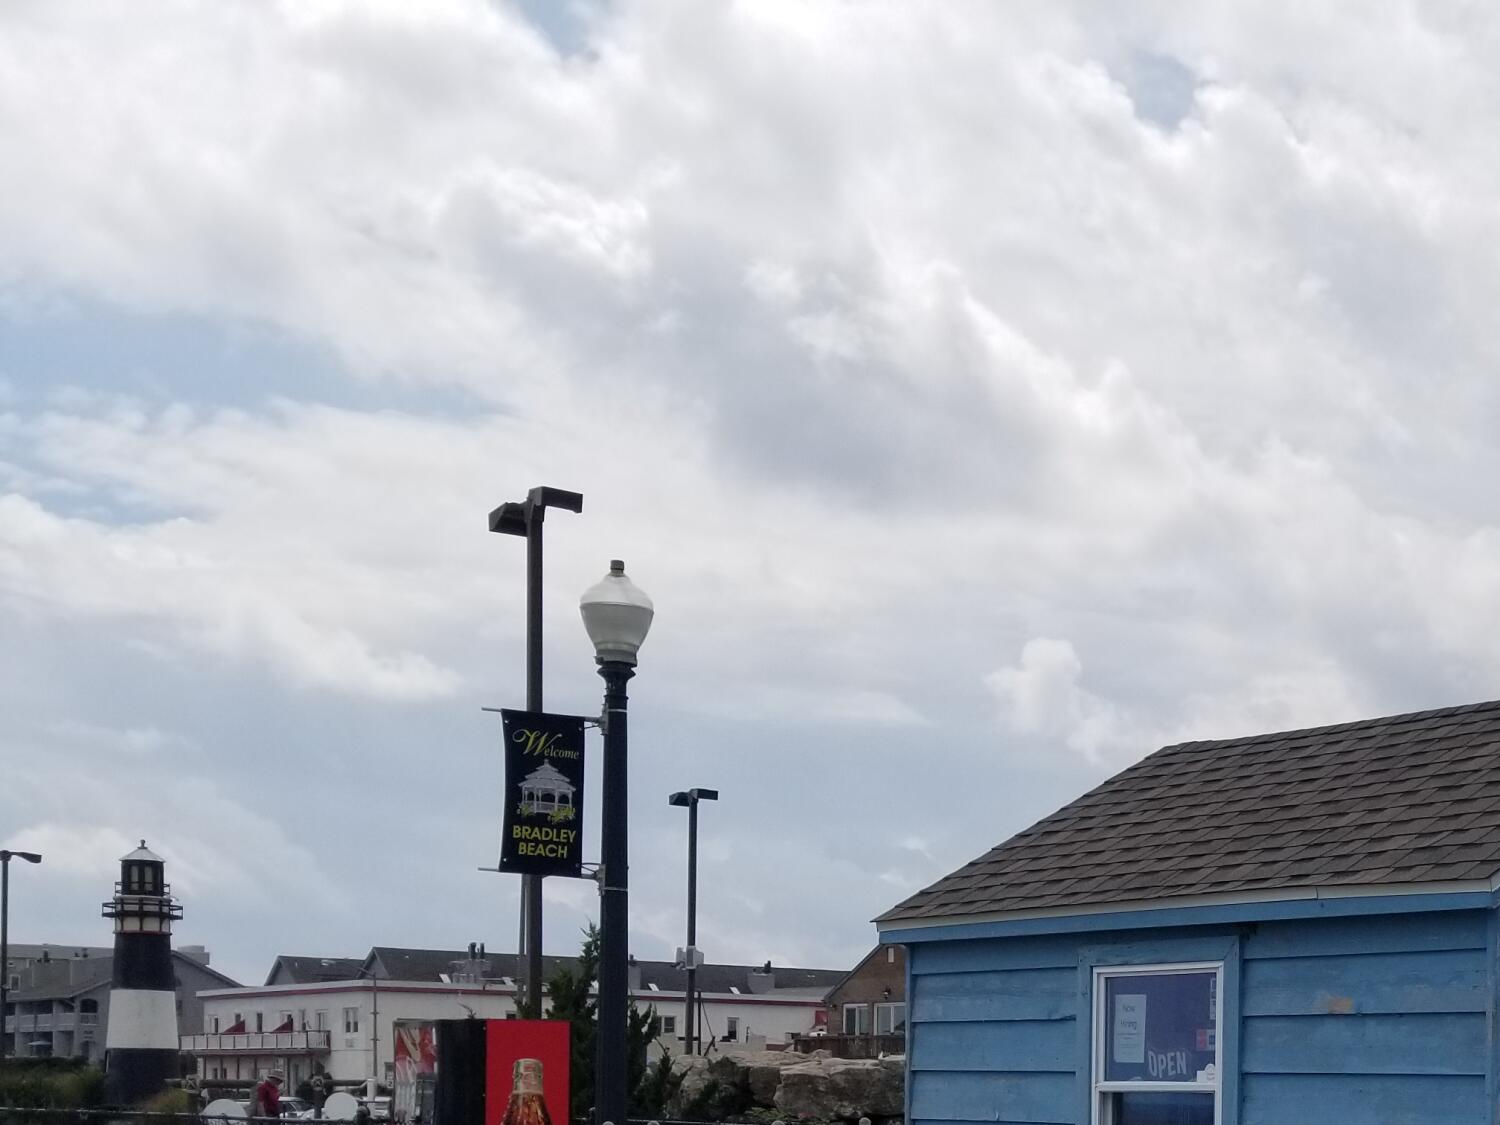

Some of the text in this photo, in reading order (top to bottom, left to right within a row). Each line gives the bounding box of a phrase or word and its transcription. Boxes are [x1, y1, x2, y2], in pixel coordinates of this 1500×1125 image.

[512, 728, 579, 760] Welcome
[512, 824, 576, 843] BRADLEY
[518, 842, 568, 859] BEACH
[1148, 1050, 1187, 1079] OPEN
